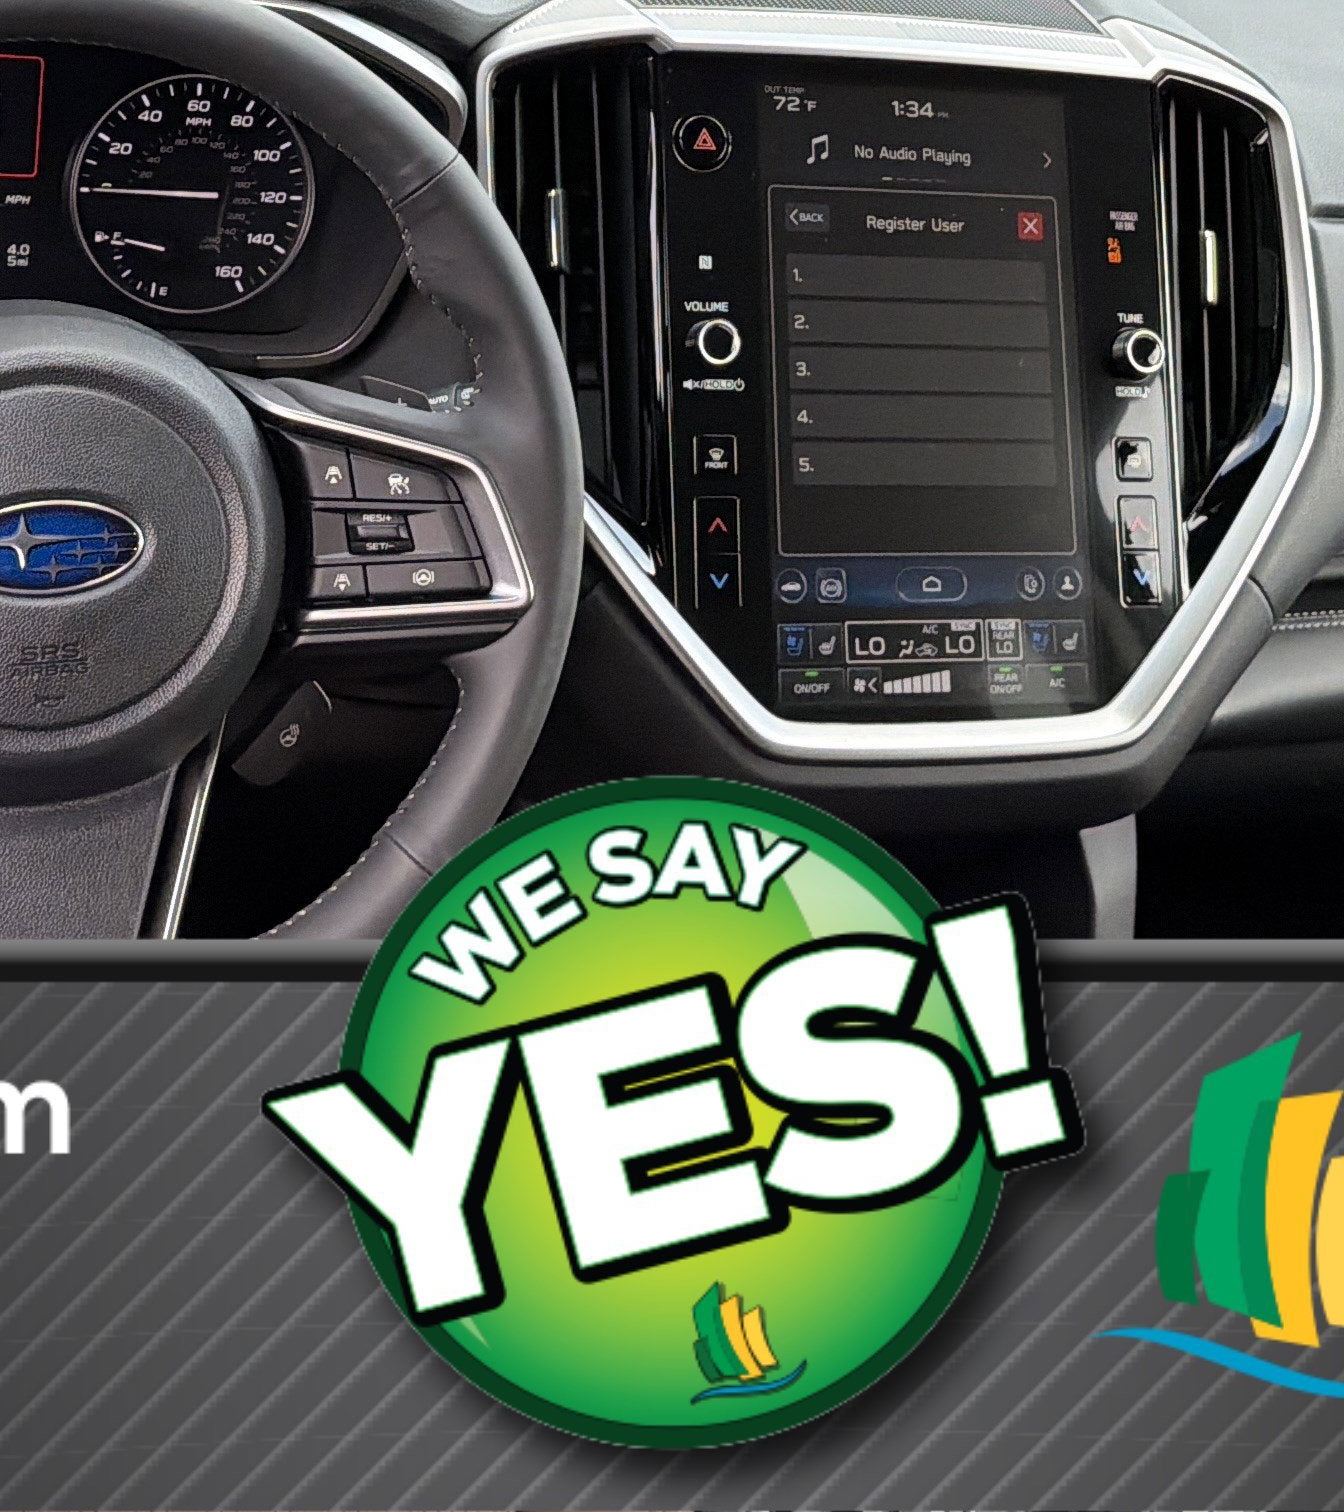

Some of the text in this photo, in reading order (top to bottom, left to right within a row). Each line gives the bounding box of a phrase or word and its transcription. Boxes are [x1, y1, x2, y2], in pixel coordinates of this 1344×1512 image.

[187, 100, 211, 112] 60
[892, 100, 934, 118] 1:34
[138, 110, 162, 122] 40
[185, 117, 212, 127] MPH
[231, 115, 255, 127] 80
[109, 143, 132, 155] 20
[253, 150, 281, 162] 100
[855, 145, 972, 167] No Audio Playing
[5, 195, 31, 205] MPH
[260, 191, 287, 204] 120
[799, 213, 824, 223] BACK
[866, 215, 965, 234] Register User
[247, 233, 274, 245] 140
[6, 244, 30, 256] 4.0
[215, 266, 243, 278] 160
[792, 268, 803, 283] 1.
[159, 286, 168, 296] E
[684, 301, 729, 312] VOLUME
[794, 314, 810, 329] 2.
[1117, 313, 1144, 324] TUNE
[795, 361, 811, 377] 3.
[796, 409, 814, 424] 4.
[798, 457, 815, 473] 5.
[922, 625, 939, 635] A/C
[855, 637, 886, 656] LO
[945, 635, 976, 654] LO
[996, 641, 1013, 654] LO
[793, 683, 830, 694] ON/OFF
[1049, 678, 1066, 688] A/C
